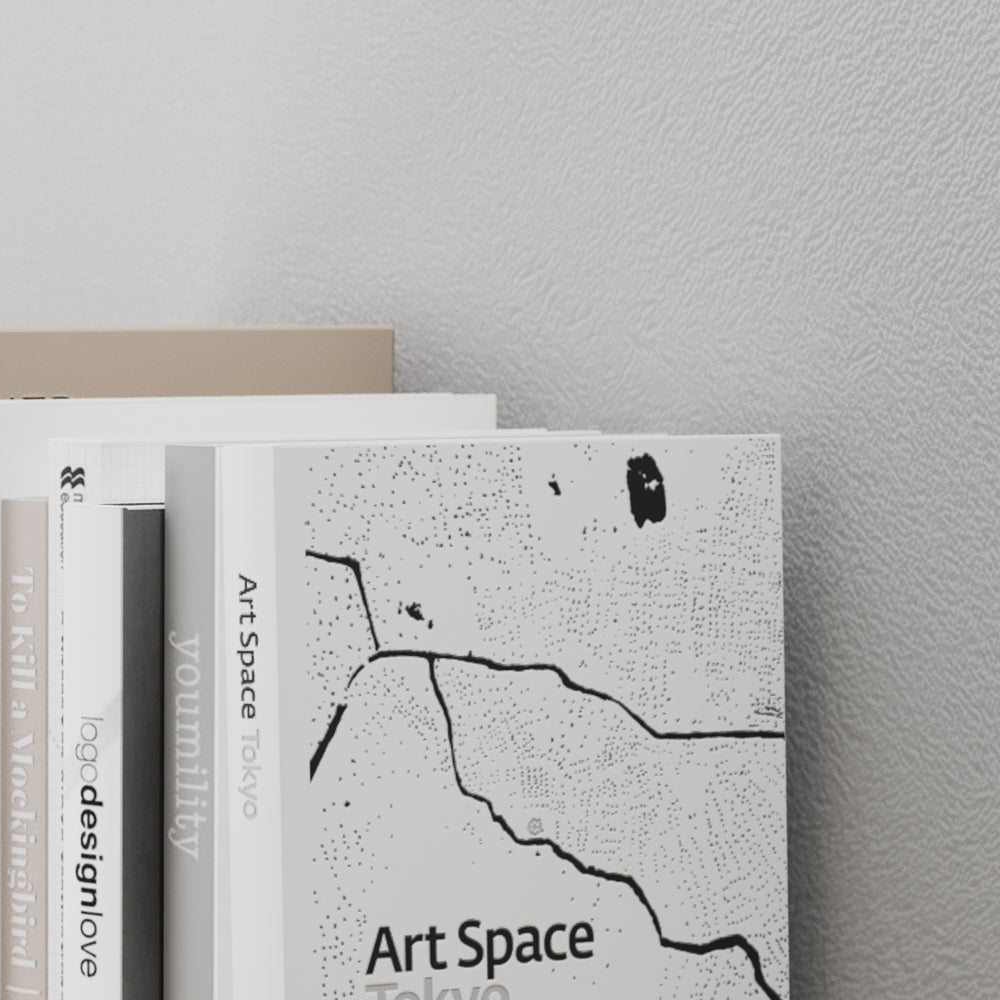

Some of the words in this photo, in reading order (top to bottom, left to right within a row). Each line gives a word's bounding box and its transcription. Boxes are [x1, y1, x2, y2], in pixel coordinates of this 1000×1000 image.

[10, 566, 35, 614] To
[238, 573, 258, 625] Art
[11, 625, 37, 691] Kill
[236, 631, 259, 719] Space
[11, 700, 28, 719] a
[168, 629, 209, 861] youmility
[238, 728, 262, 821] Tokyo
[7, 732, 37, 969] Mockingbird
[365, 926, 448, 976] Art
[457, 918, 595, 981] Space
